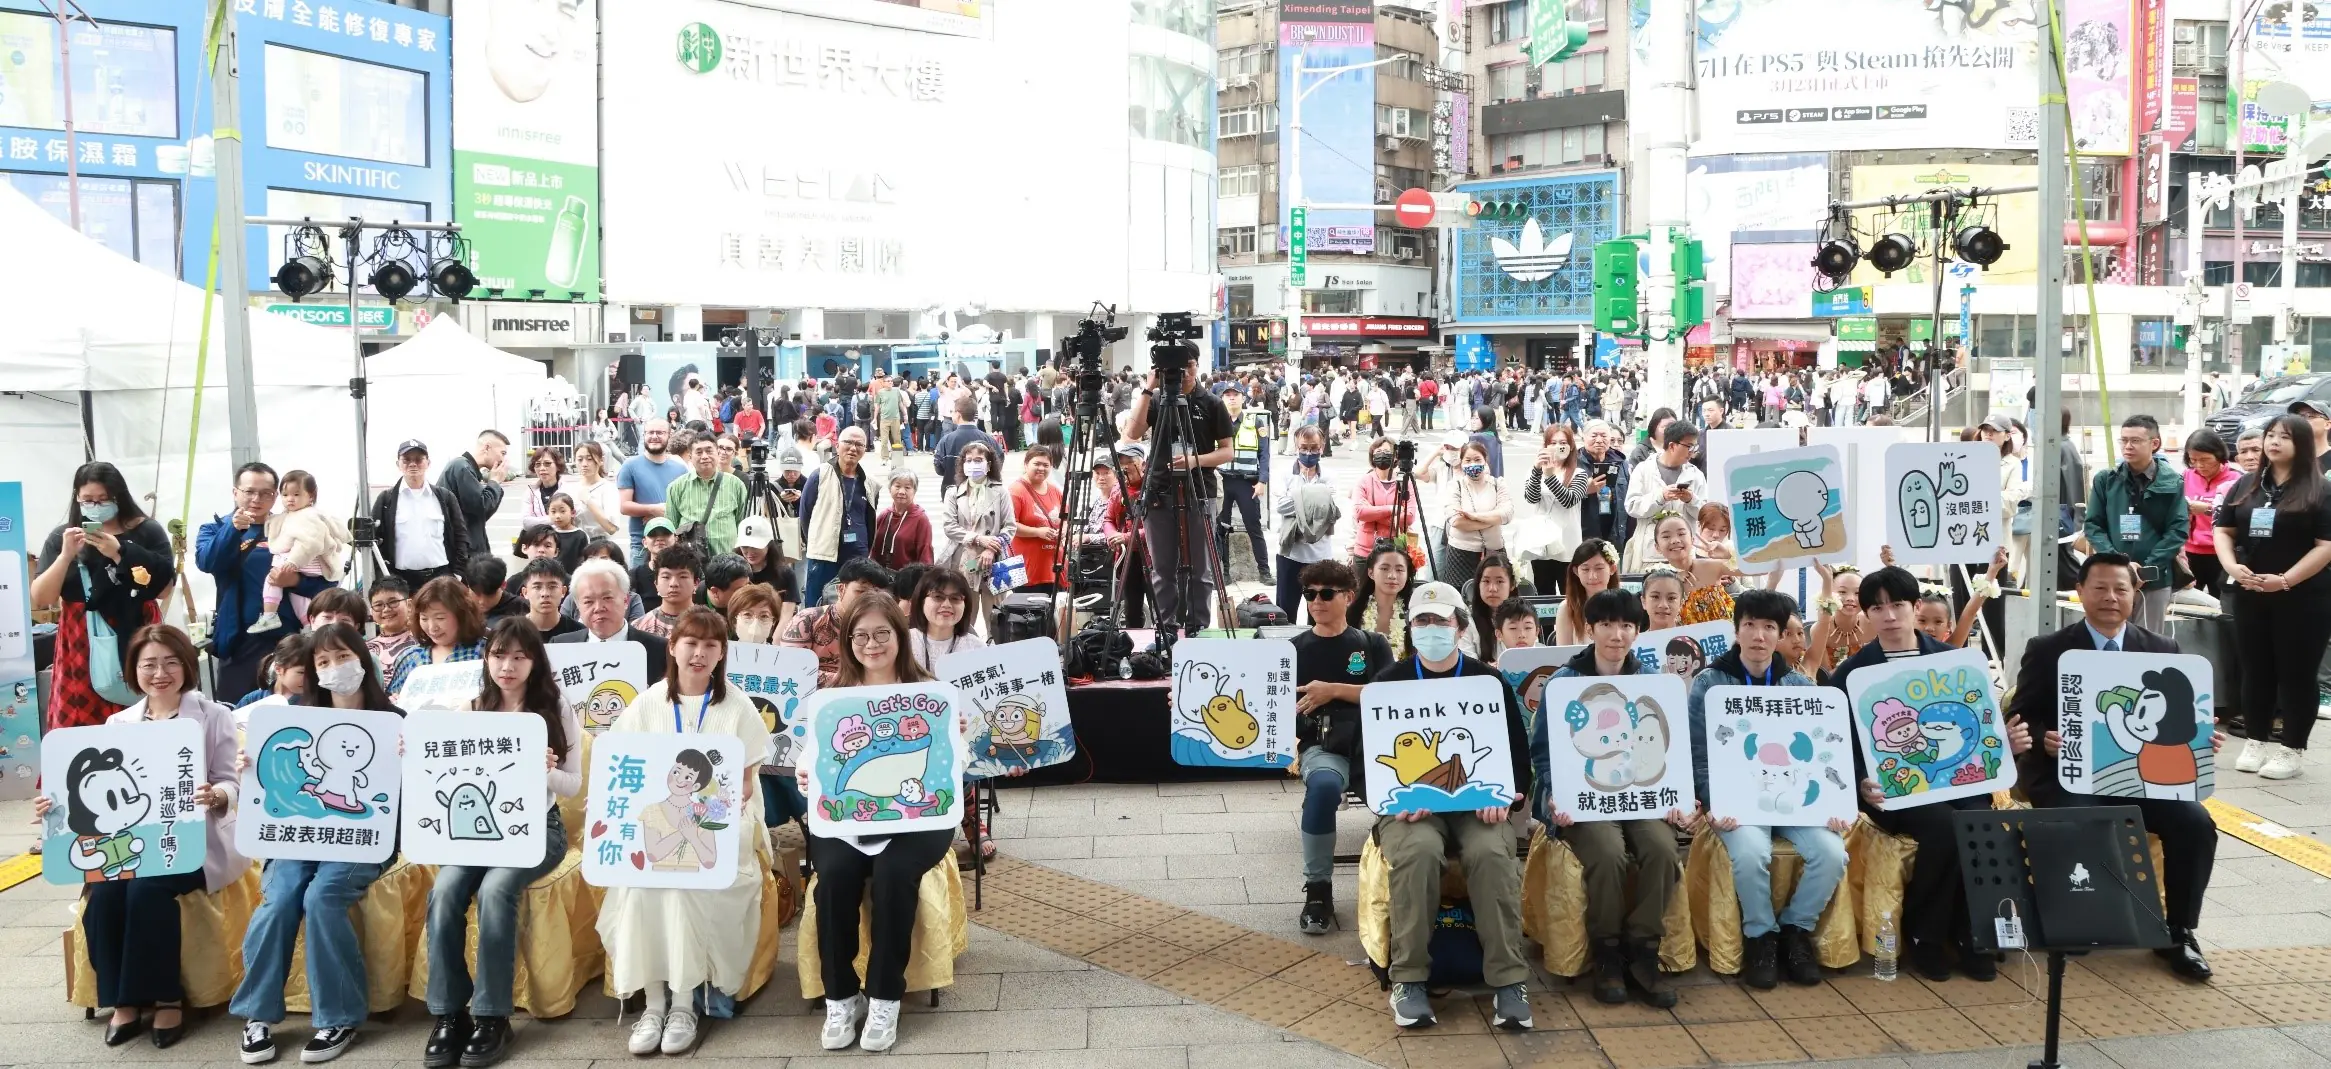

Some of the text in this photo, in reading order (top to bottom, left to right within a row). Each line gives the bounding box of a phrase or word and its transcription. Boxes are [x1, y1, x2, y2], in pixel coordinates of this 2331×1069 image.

[1284, 5, 1371, 17] Ximending Taipei
[723, 29, 946, 103] 新世界大樓
[1761, 53, 1804, 74] PS5
[1843, 49, 1917, 72] Steam
[1922, 45, 2014, 70] 搶先公開
[1753, 112, 1779, 121] PS5
[1802, 111, 1824, 119] STEAM
[1844, 107, 1870, 117] App Store
[1891, 104, 1925, 115] Google Play
[0, 136, 137, 167] 胺保濕霜
[304, 161, 401, 190] SKINTIFIC
[476, 168, 563, 189] NEW 新品上市
[1293, 216, 1303, 254] 漢中街
[1832, 293, 1849, 304] 西門站
[1862, 293, 1870, 309] 6
[1742, 489, 1767, 538] 掰掰
[1945, 500, 1990, 516] 沒問題!
[745, 526, 752, 536] C
[1279, 657, 1291, 695] 我還小
[868, 693, 948, 718] Let's Go!
[1265, 672, 1278, 762] 別跟小浪花計較
[1371, 701, 1500, 721] Thank You
[1724, 697, 1836, 717] 媽媽拜託啦~
[424, 737, 522, 759] 兒童節快樂!
[178, 746, 196, 813] 今天開始
[1577, 788, 1680, 815] 就想黏著你
[159, 786, 178, 868] 海巡了嗎?
[258, 823, 380, 847] 這波表現超讚!
